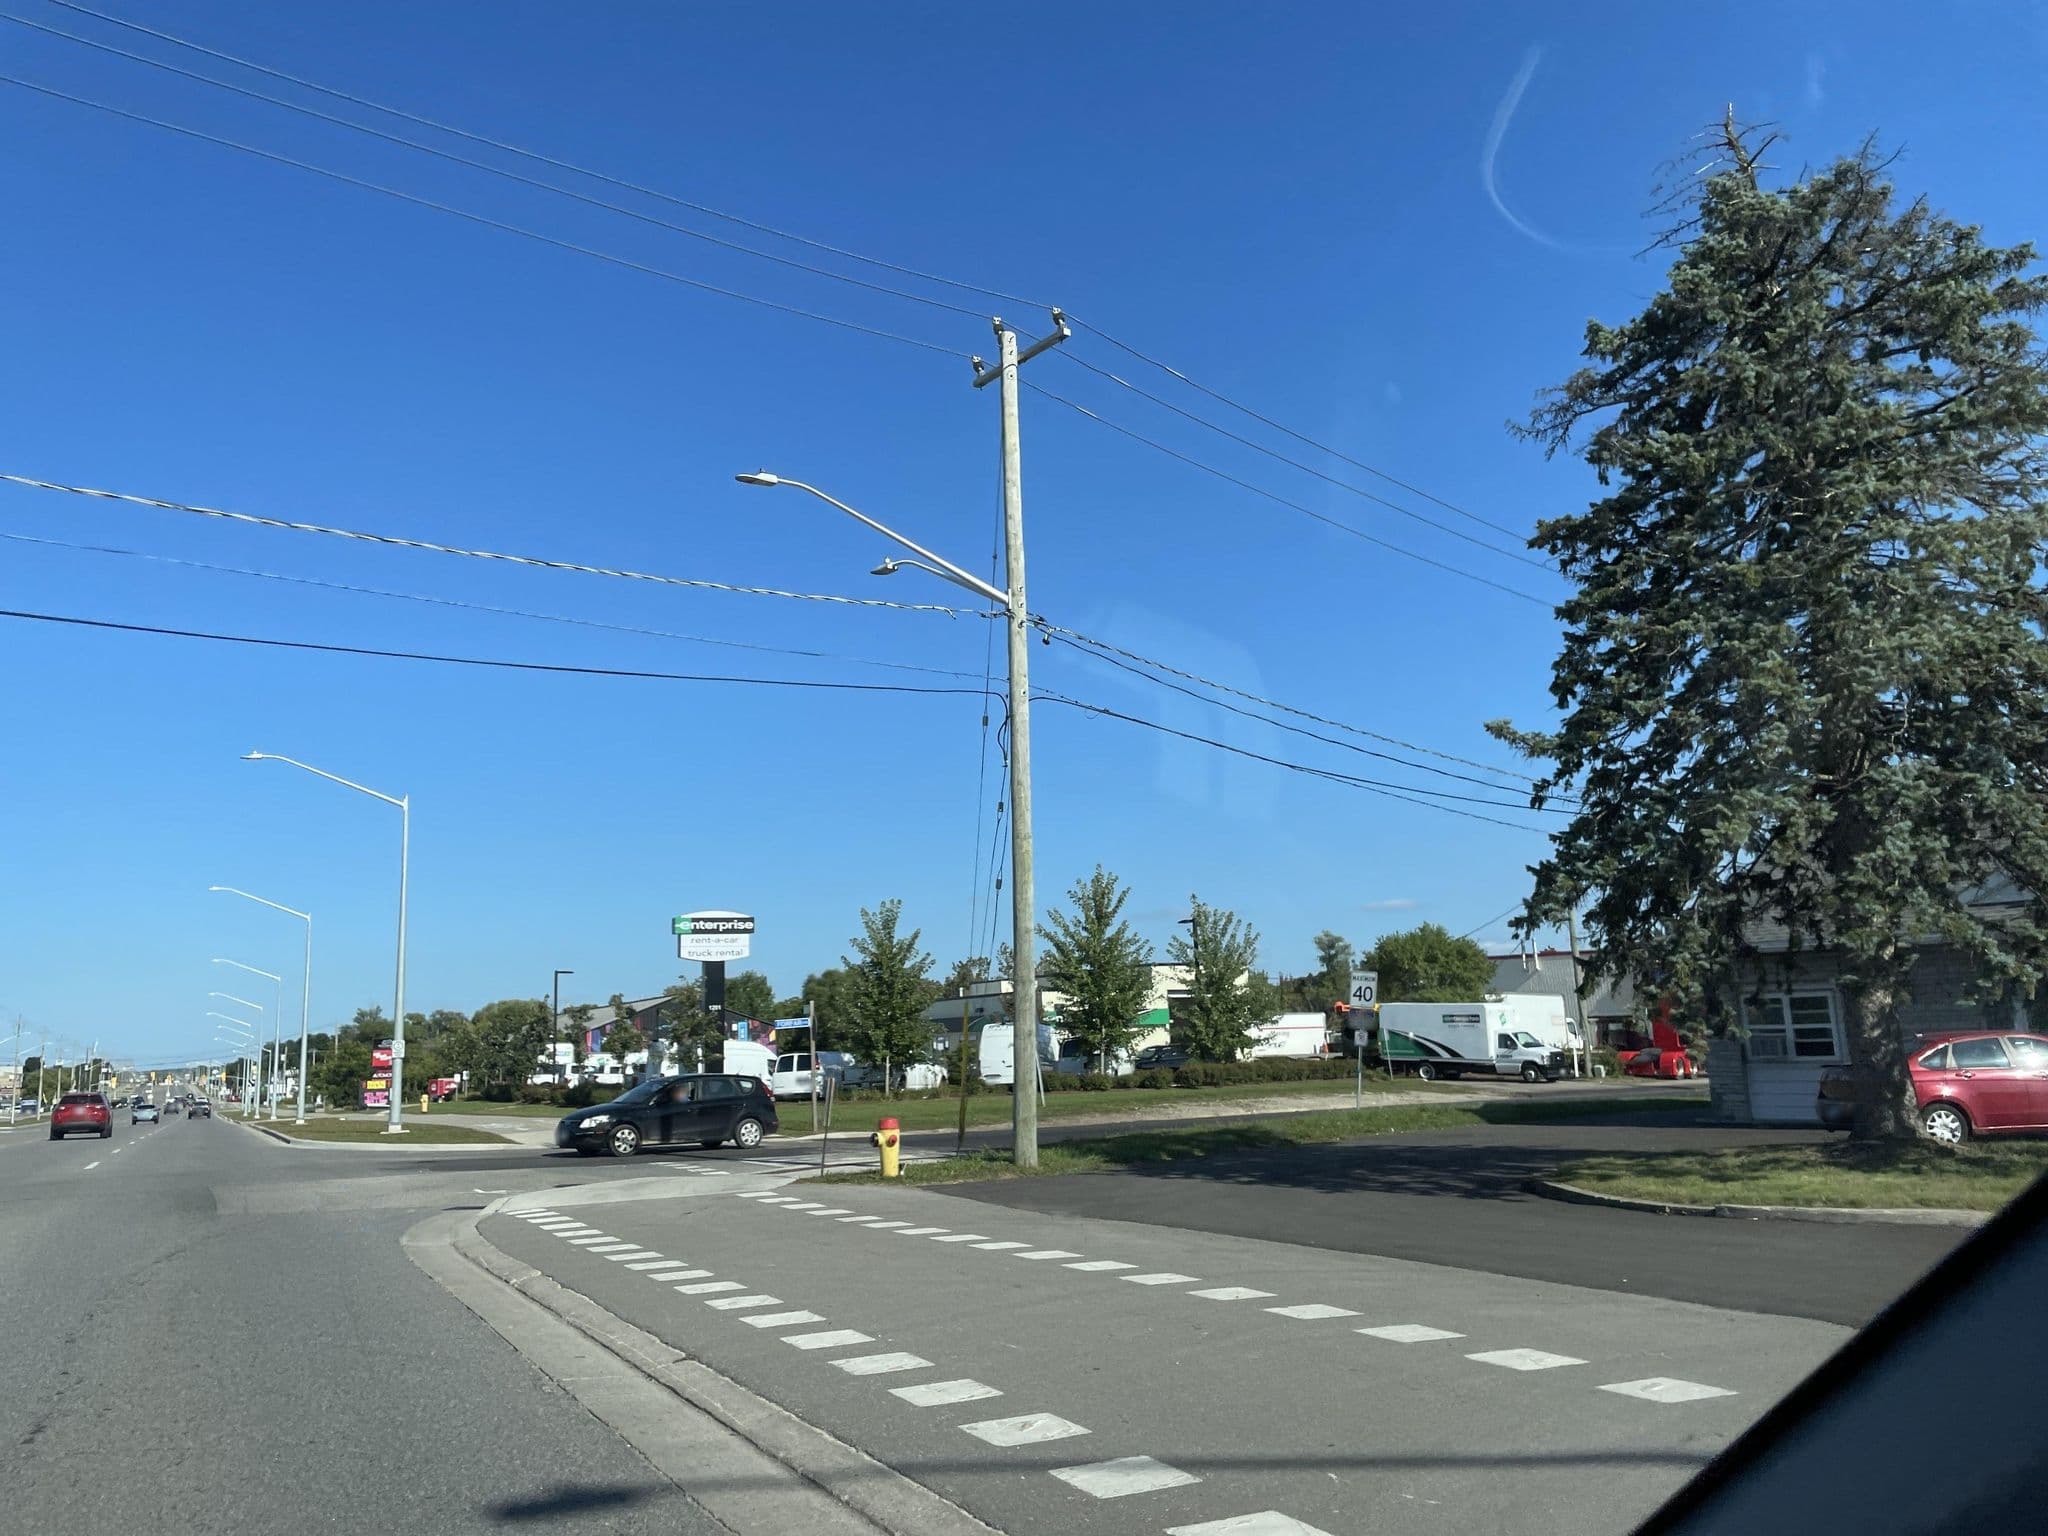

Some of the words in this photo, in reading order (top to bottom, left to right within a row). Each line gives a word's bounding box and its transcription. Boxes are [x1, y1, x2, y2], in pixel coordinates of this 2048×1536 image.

[676, 919, 754, 931] enterprise
[690, 936, 740, 944] rent-a-car
[688, 949, 712, 957] truck
[715, 949, 744, 957] rental
[1353, 986, 1373, 1002] 40
